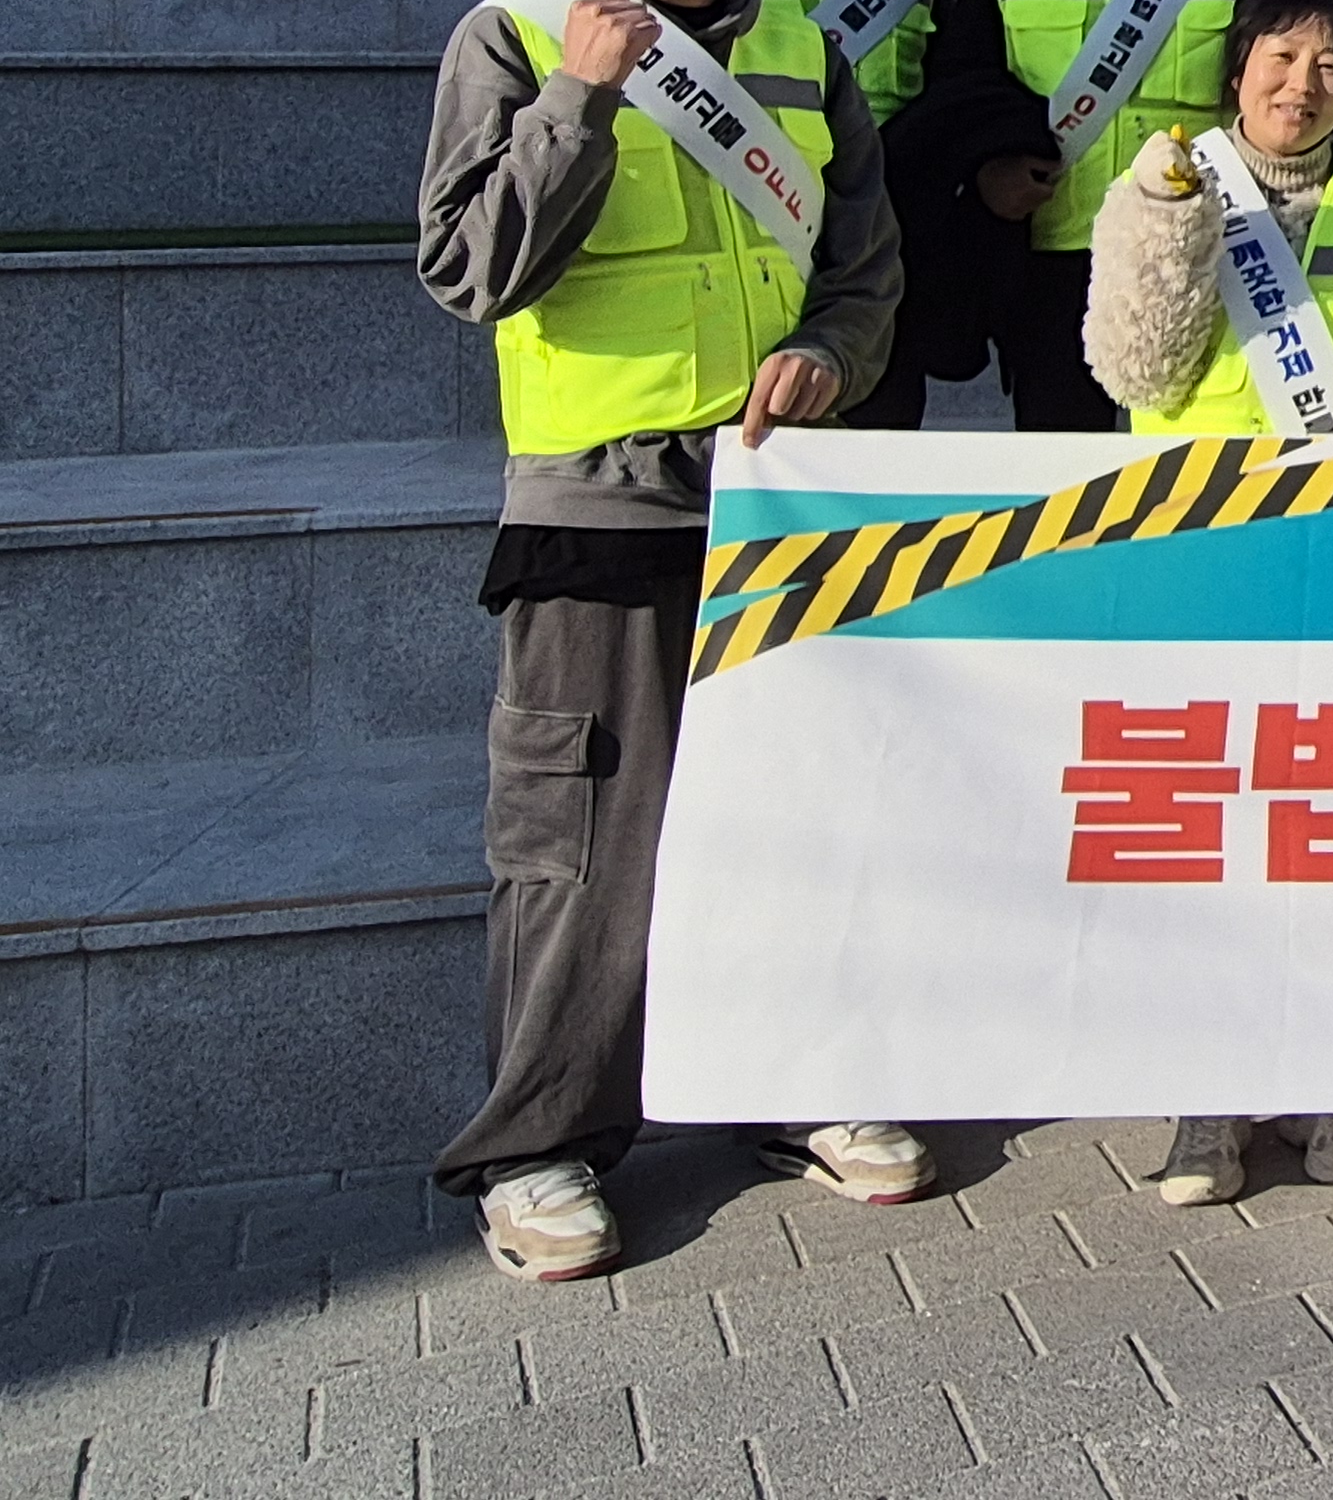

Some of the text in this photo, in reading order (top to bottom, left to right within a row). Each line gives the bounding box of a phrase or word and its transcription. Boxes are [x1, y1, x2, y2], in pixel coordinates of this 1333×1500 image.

[657, 66, 802, 222] 광고물 OFF
[1055, 94, 1096, 143] OF
[1228, 239, 1287, 318] 깨끗한
[1267, 322, 1315, 382] 거제
